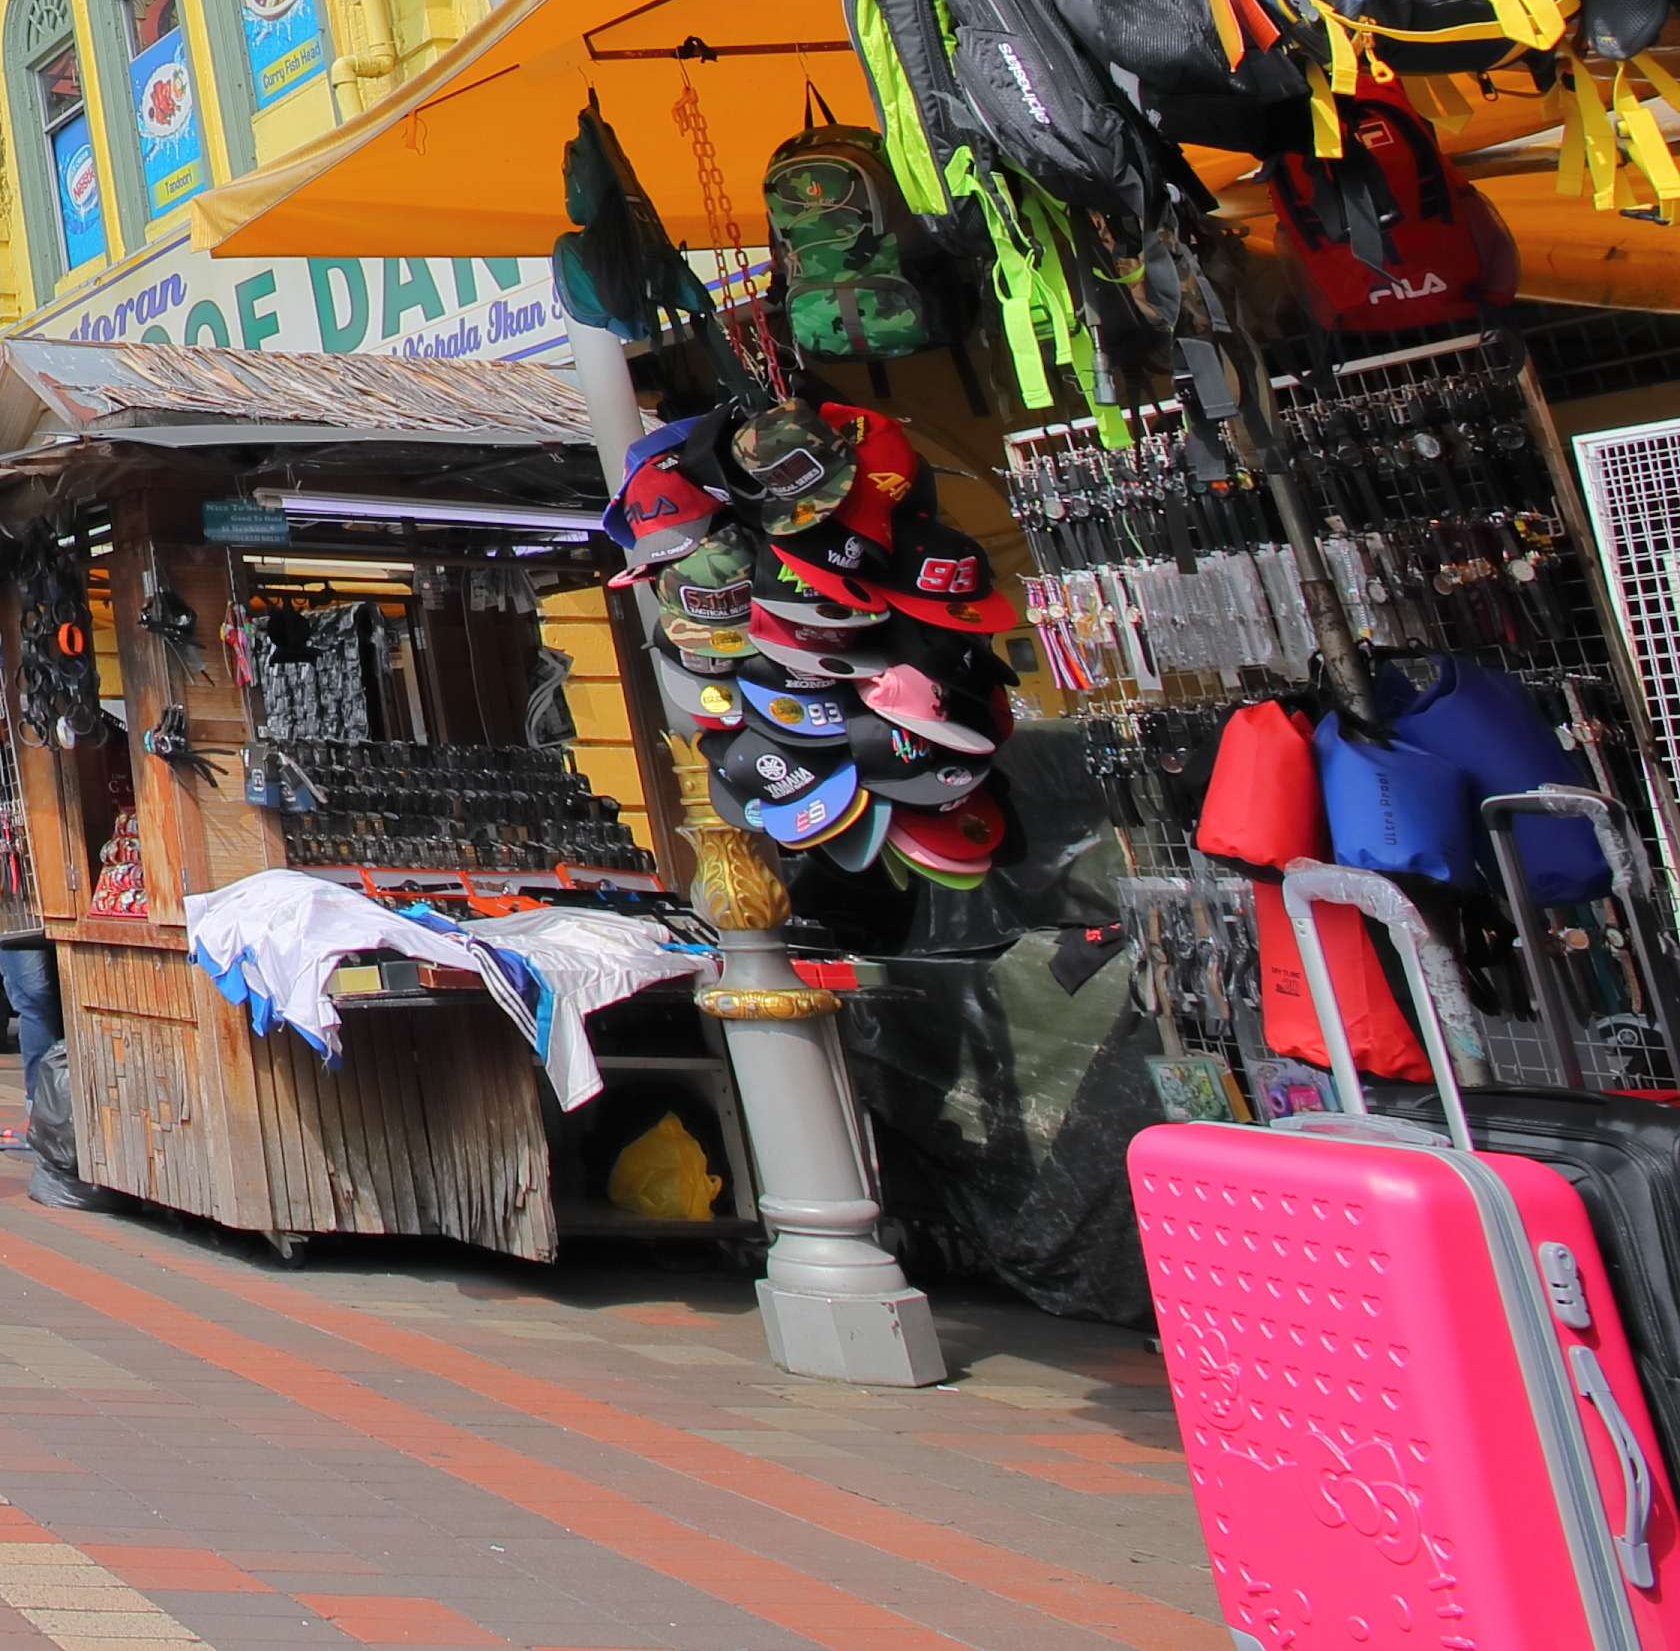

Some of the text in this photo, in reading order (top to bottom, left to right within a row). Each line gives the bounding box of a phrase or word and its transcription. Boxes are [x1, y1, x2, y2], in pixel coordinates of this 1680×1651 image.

[262, 42, 322, 91] Curry Fish Head
[998, 43, 1051, 124] alpinestars
[163, 169, 194, 198] Tandoori
[1369, 272, 1447, 305] FILA
[488, 294, 546, 348] Ikan
[917, 556, 978, 594] 93
[808, 702, 844, 726] 93
[764, 766, 815, 799] YAMAHA
[1383, 808, 1398, 847] Ultra
